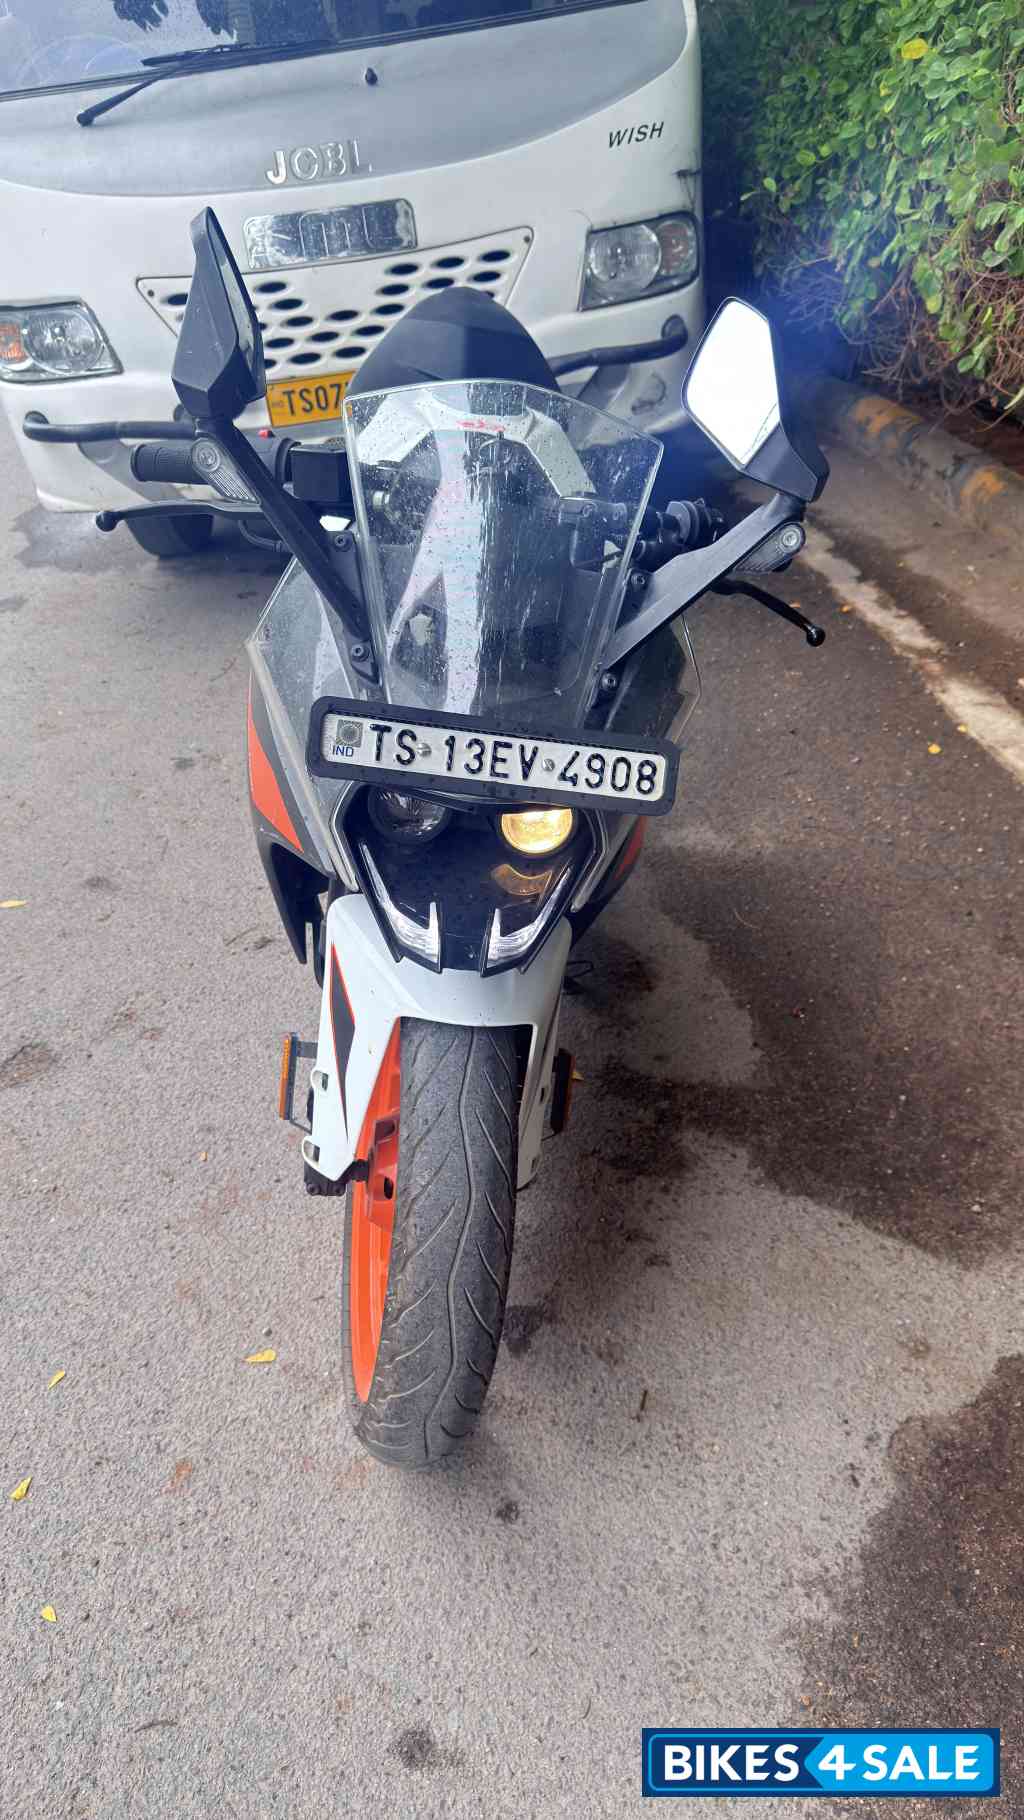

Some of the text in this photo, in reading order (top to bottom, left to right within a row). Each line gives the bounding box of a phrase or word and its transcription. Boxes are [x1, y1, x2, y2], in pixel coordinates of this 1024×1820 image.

[608, 121, 664, 148] WISH
[282, 381, 350, 416] TS07
[332, 745, 354, 757] IND
[369, 723, 658, 796] TS 13EV 4908
